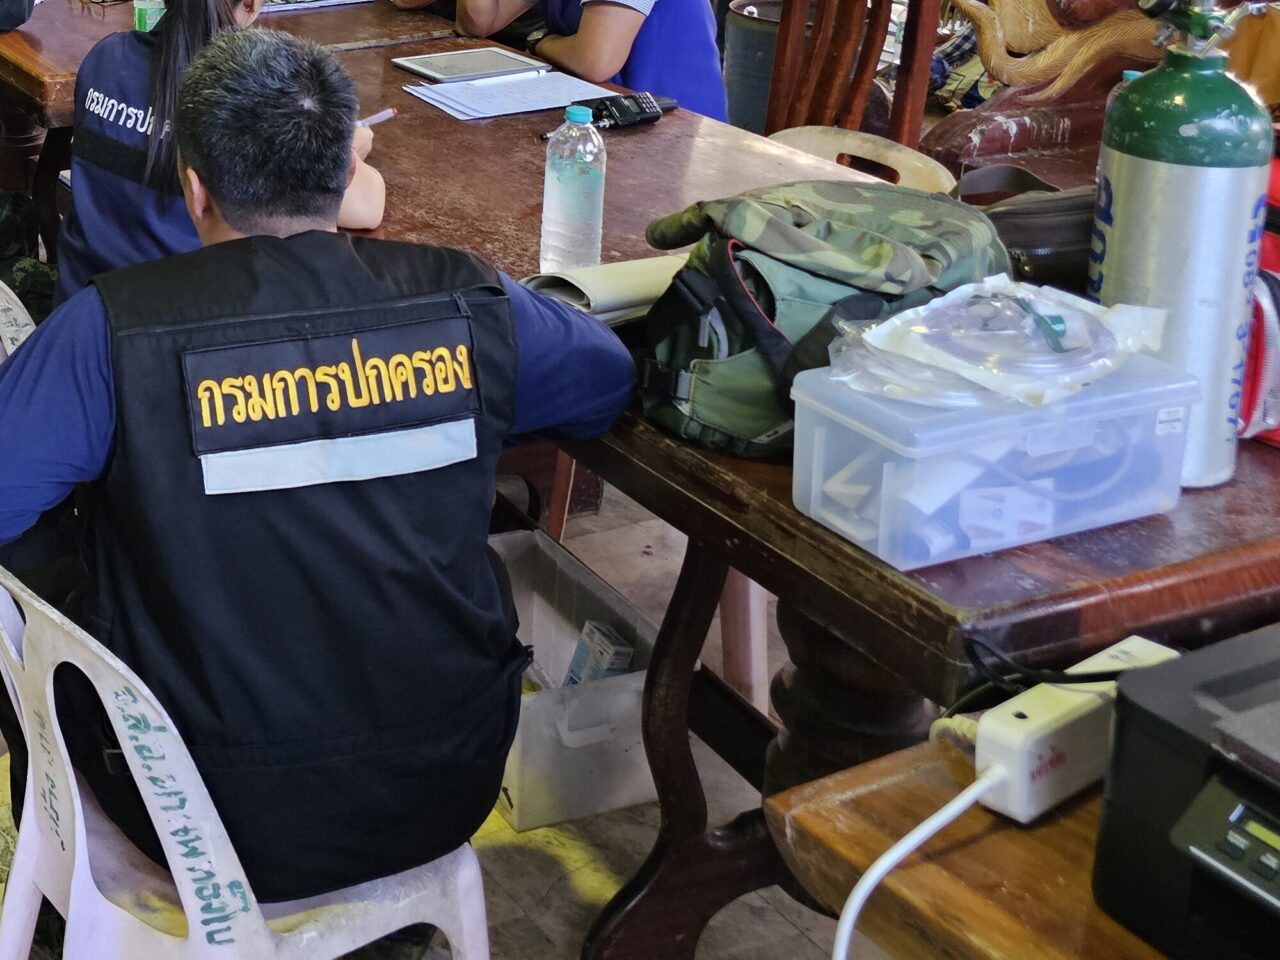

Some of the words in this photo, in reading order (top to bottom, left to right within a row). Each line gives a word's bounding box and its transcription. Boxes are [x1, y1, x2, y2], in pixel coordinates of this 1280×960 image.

[197, 338, 473, 427] กรมการปกครอง
